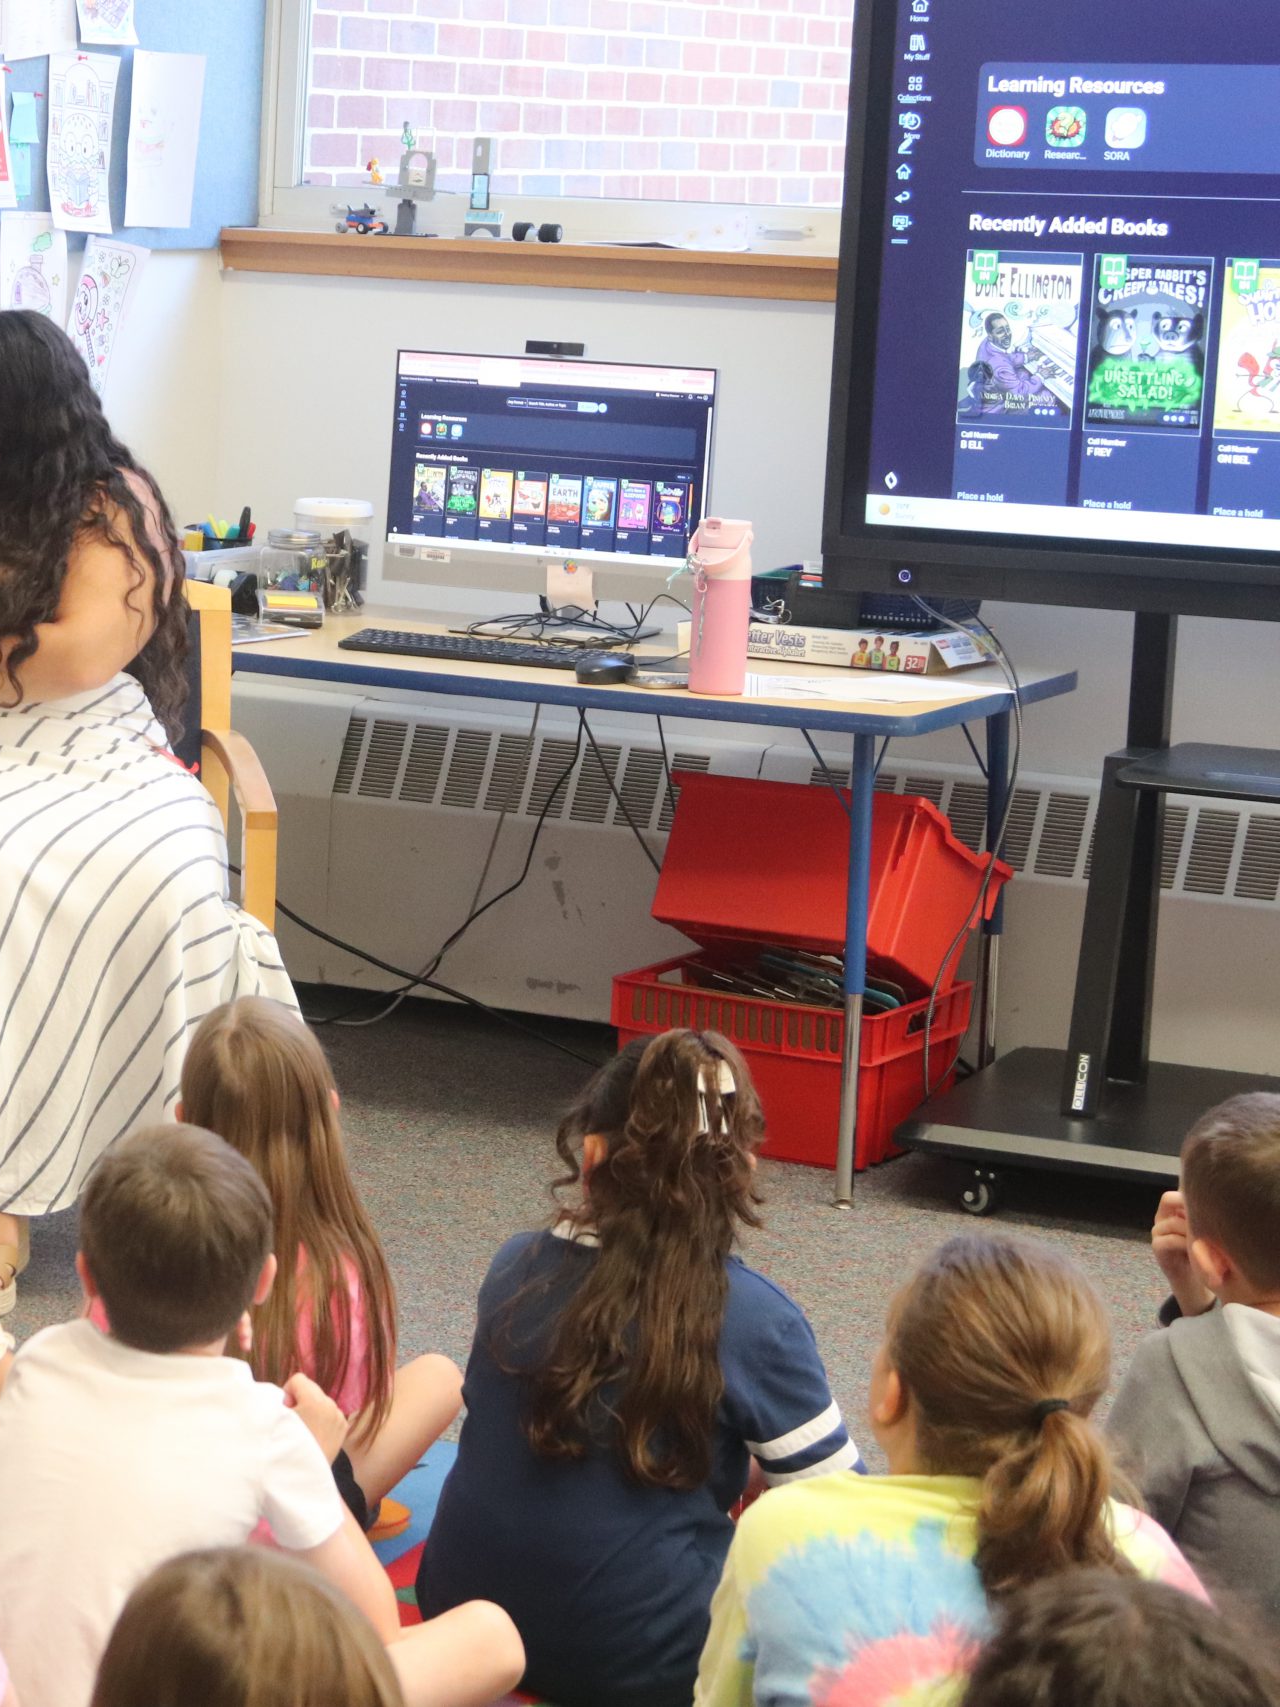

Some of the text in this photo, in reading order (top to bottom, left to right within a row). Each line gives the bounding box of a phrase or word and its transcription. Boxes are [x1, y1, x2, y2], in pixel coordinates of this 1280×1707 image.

[910, 14, 929, 22] Home
[904, 53, 930, 62] My Stuff
[988, 75, 1165, 97] Learning Resources
[897, 94, 932, 102] Collections
[985, 149, 1030, 160] Dictionary
[1104, 151, 1130, 161] SORA
[969, 214, 1169, 237] Recently Added Books
[979, 272, 990, 281] IN
[1125, 268, 1207, 286] SPER RABBIT'S
[1010, 267, 1072, 299] ELLINGTON
[1158, 281, 1206, 308] TALES!
[1104, 370, 1185, 387] UNSETTLING
[1117, 384, 1173, 400] SALAD!
[960, 431, 999, 440] Call Number
[1094, 448, 1113, 457] REY
[552, 487, 578, 498] EARTH
[956, 491, 978, 501] Place
[986, 492, 1004, 502] hold
[1083, 499, 1106, 509] Place
[1113, 500, 1132, 510] hold
[1213, 507, 1236, 516] Place
[1244, 508, 1264, 518] hold
[747, 629, 774, 644] etter
[775, 630, 806, 647] Vests
[747, 645, 778, 655] nteractive
[906, 657, 918, 669] 32
[1072, 1054, 1090, 1110] OLLICON
